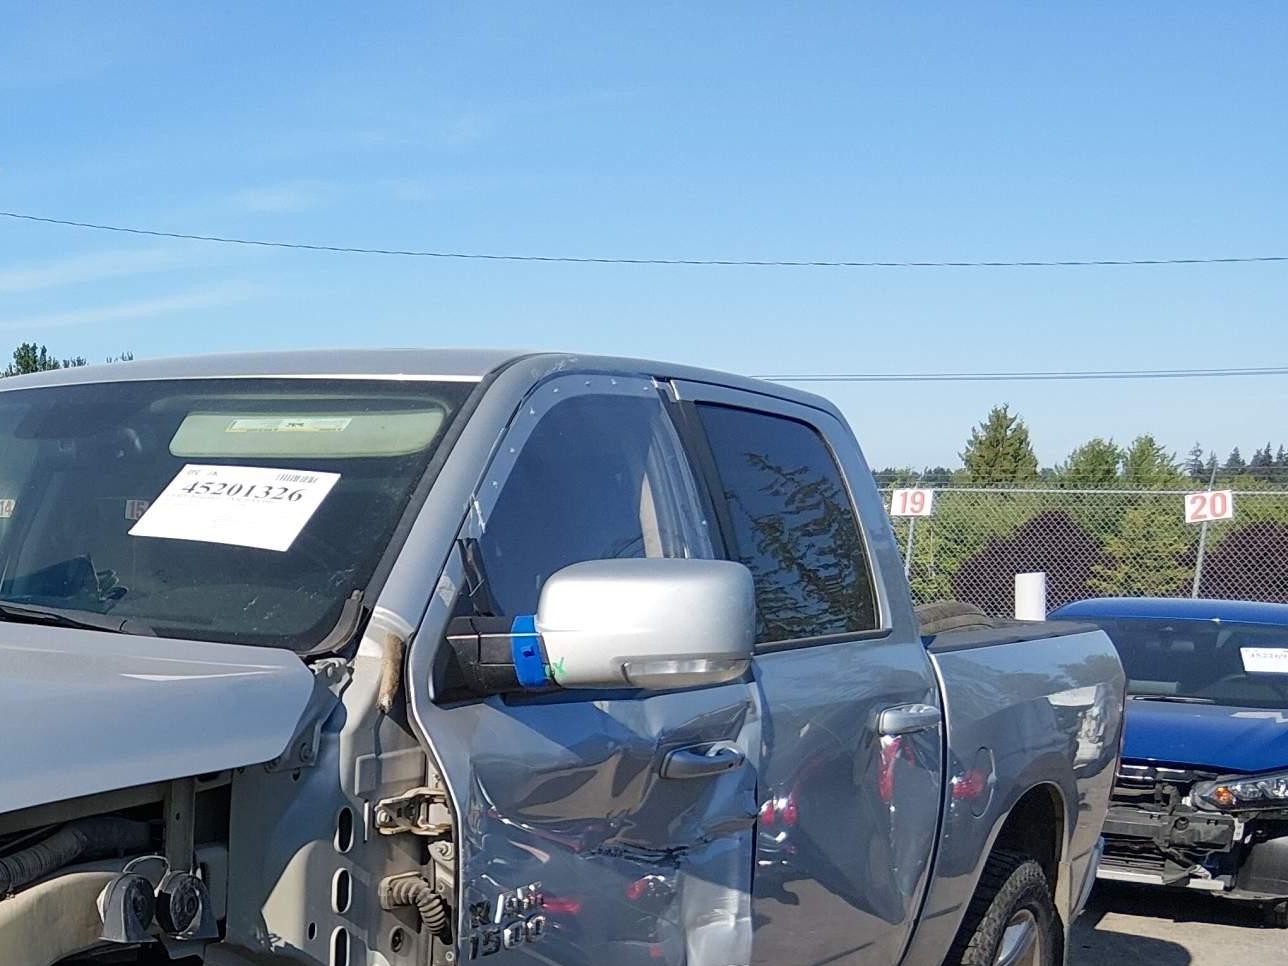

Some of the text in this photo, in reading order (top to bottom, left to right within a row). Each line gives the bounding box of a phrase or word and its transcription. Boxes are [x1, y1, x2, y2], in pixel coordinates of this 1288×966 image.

[181, 481, 307, 503] 45201326
[900, 490, 925, 514] 19
[1190, 492, 1227, 521] 20
[469, 914, 546, 961] 1500
